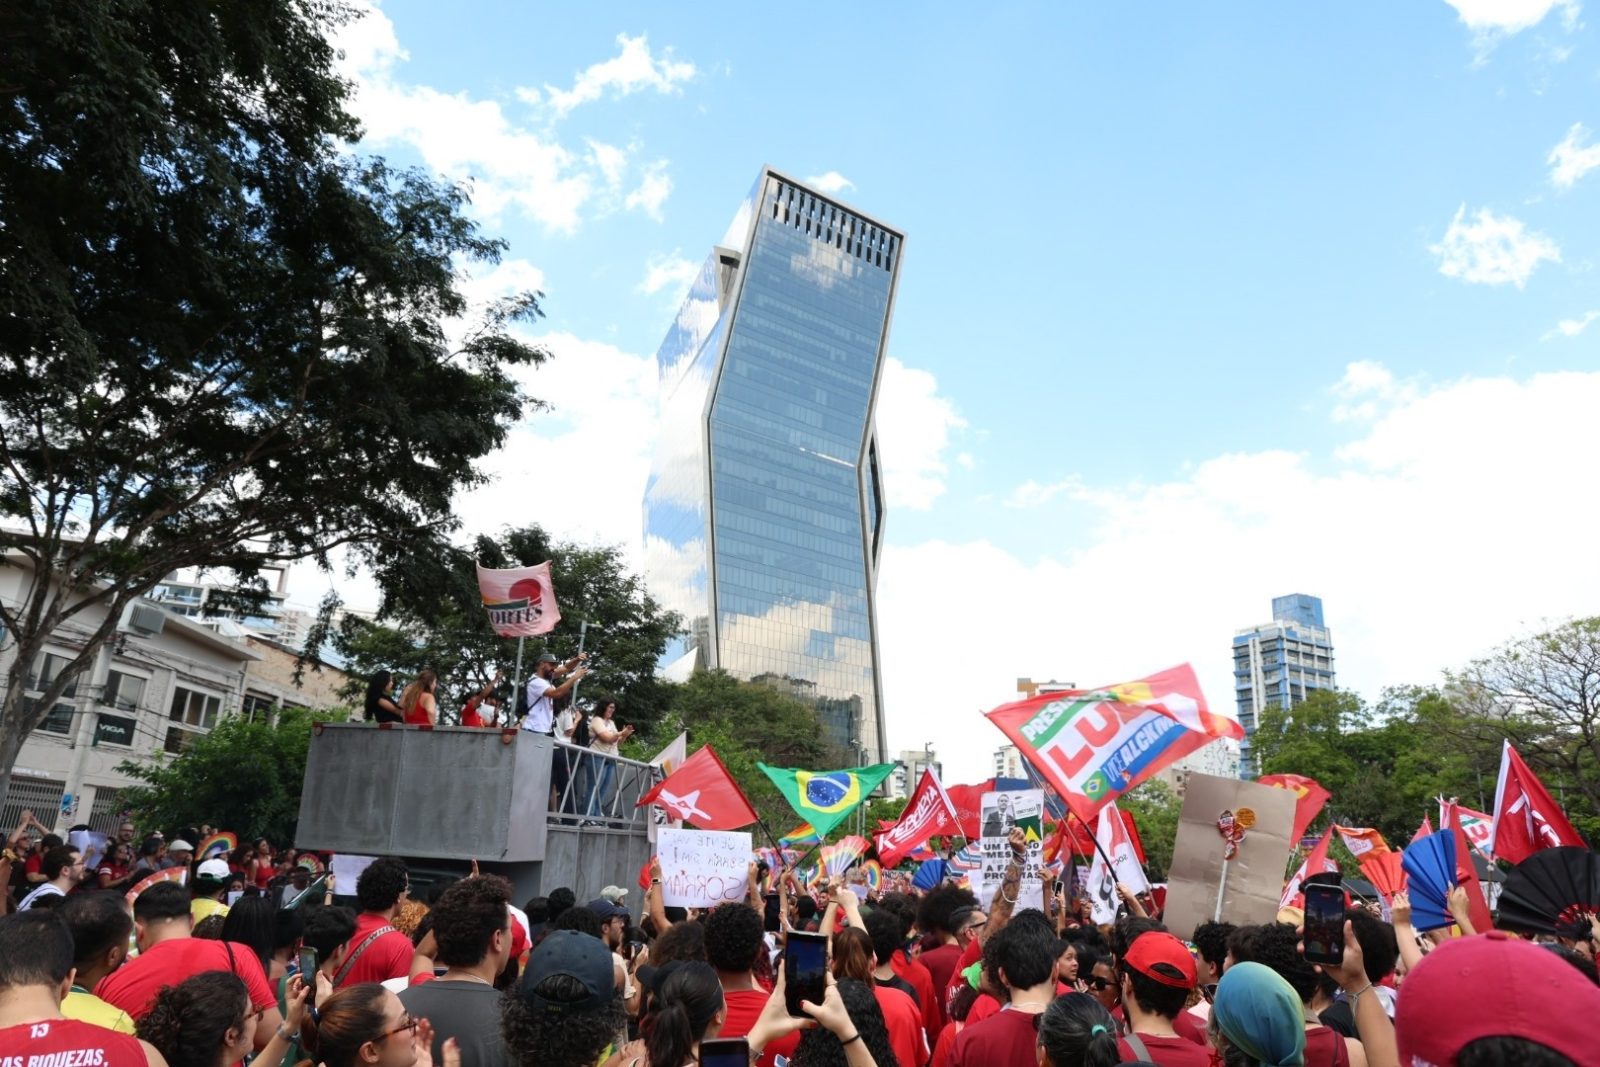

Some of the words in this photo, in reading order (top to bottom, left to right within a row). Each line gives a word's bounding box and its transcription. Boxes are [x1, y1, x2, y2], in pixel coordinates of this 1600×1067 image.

[1119, 716, 1176, 767] ALCKM
[983, 843, 1001, 851] UM
[1004, 842, 1040, 850] FSO
[986, 850, 1037, 859] MESAS
[987, 864, 994, 872] A
[984, 871, 1041, 880] PROTAS
[30, 1022, 50, 1039] 13
[0, 1056, 24, 1067] AS
